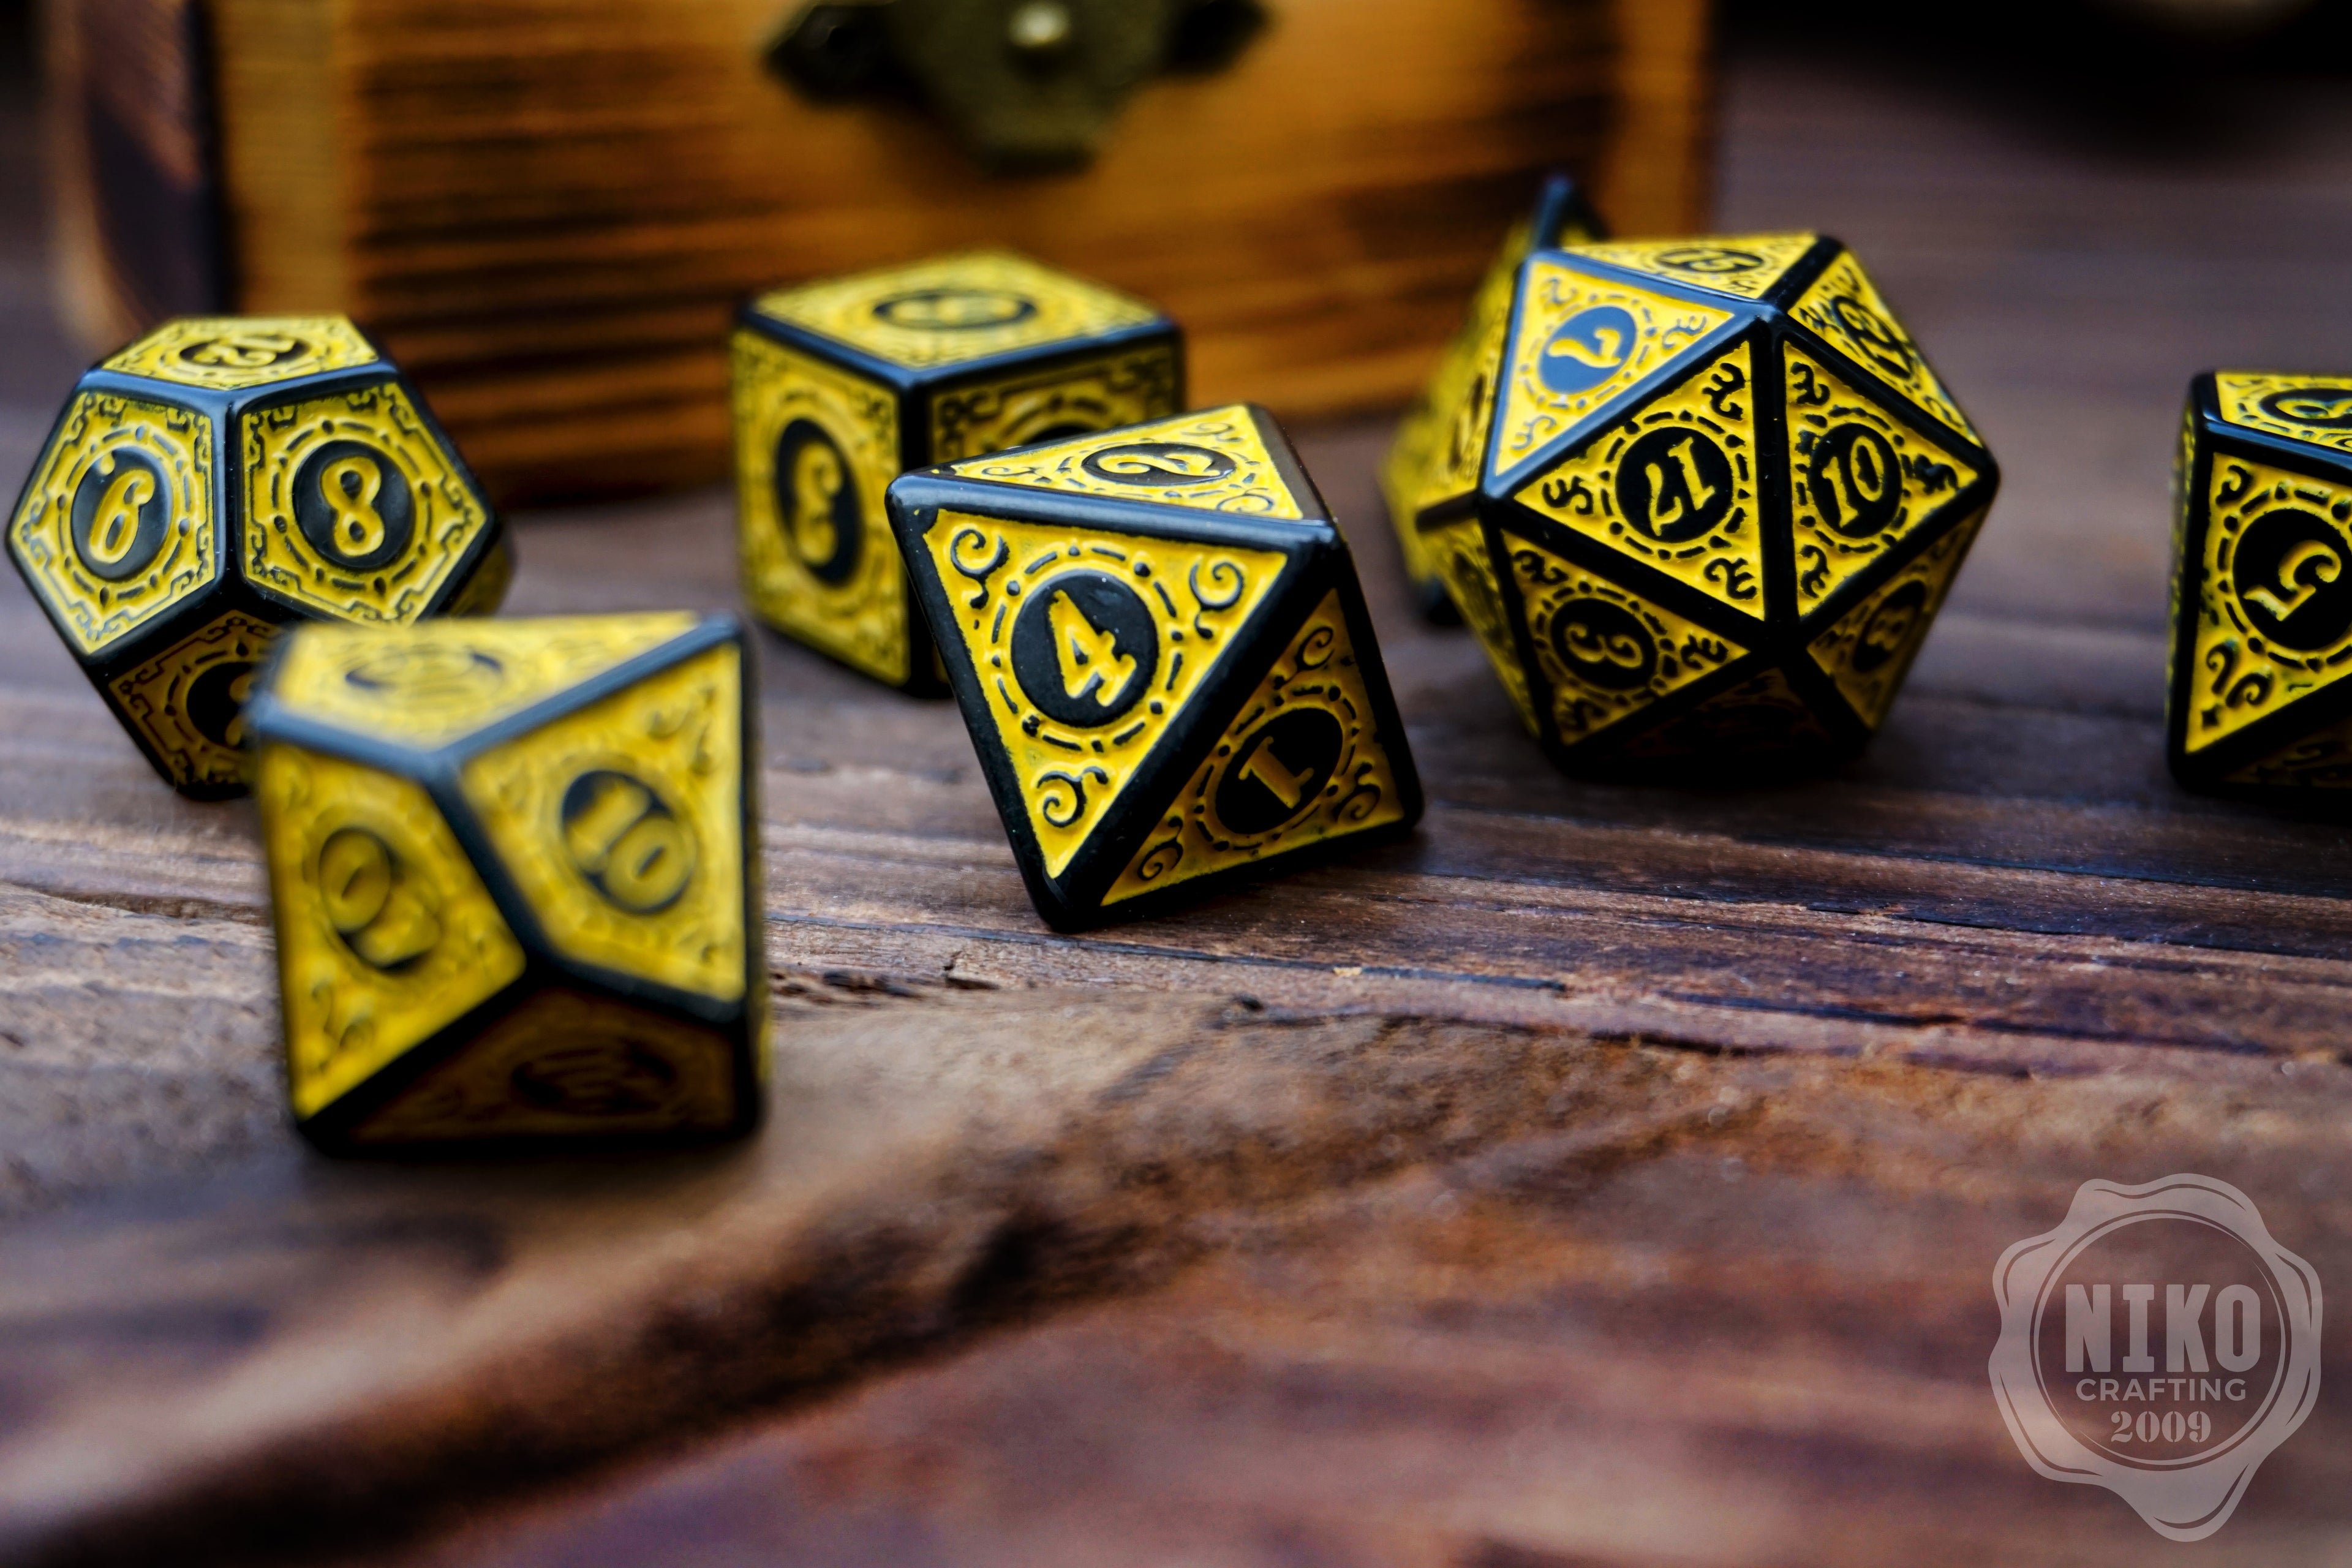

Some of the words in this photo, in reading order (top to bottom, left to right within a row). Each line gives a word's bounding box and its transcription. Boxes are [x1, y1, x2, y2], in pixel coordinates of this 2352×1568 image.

[1547, 330, 1623, 369] 7
[320, 454, 385, 557] 8
[1097, 452, 1221, 478] 2
[1643, 439, 1715, 537] 17
[1821, 435, 1886, 528] 10
[2243, 540, 2342, 622] 5
[1048, 589, 1137, 708] 4
[1564, 622, 1645, 669] 3
[1238, 735, 1316, 810] 1
[565, 778, 695, 913] 10
